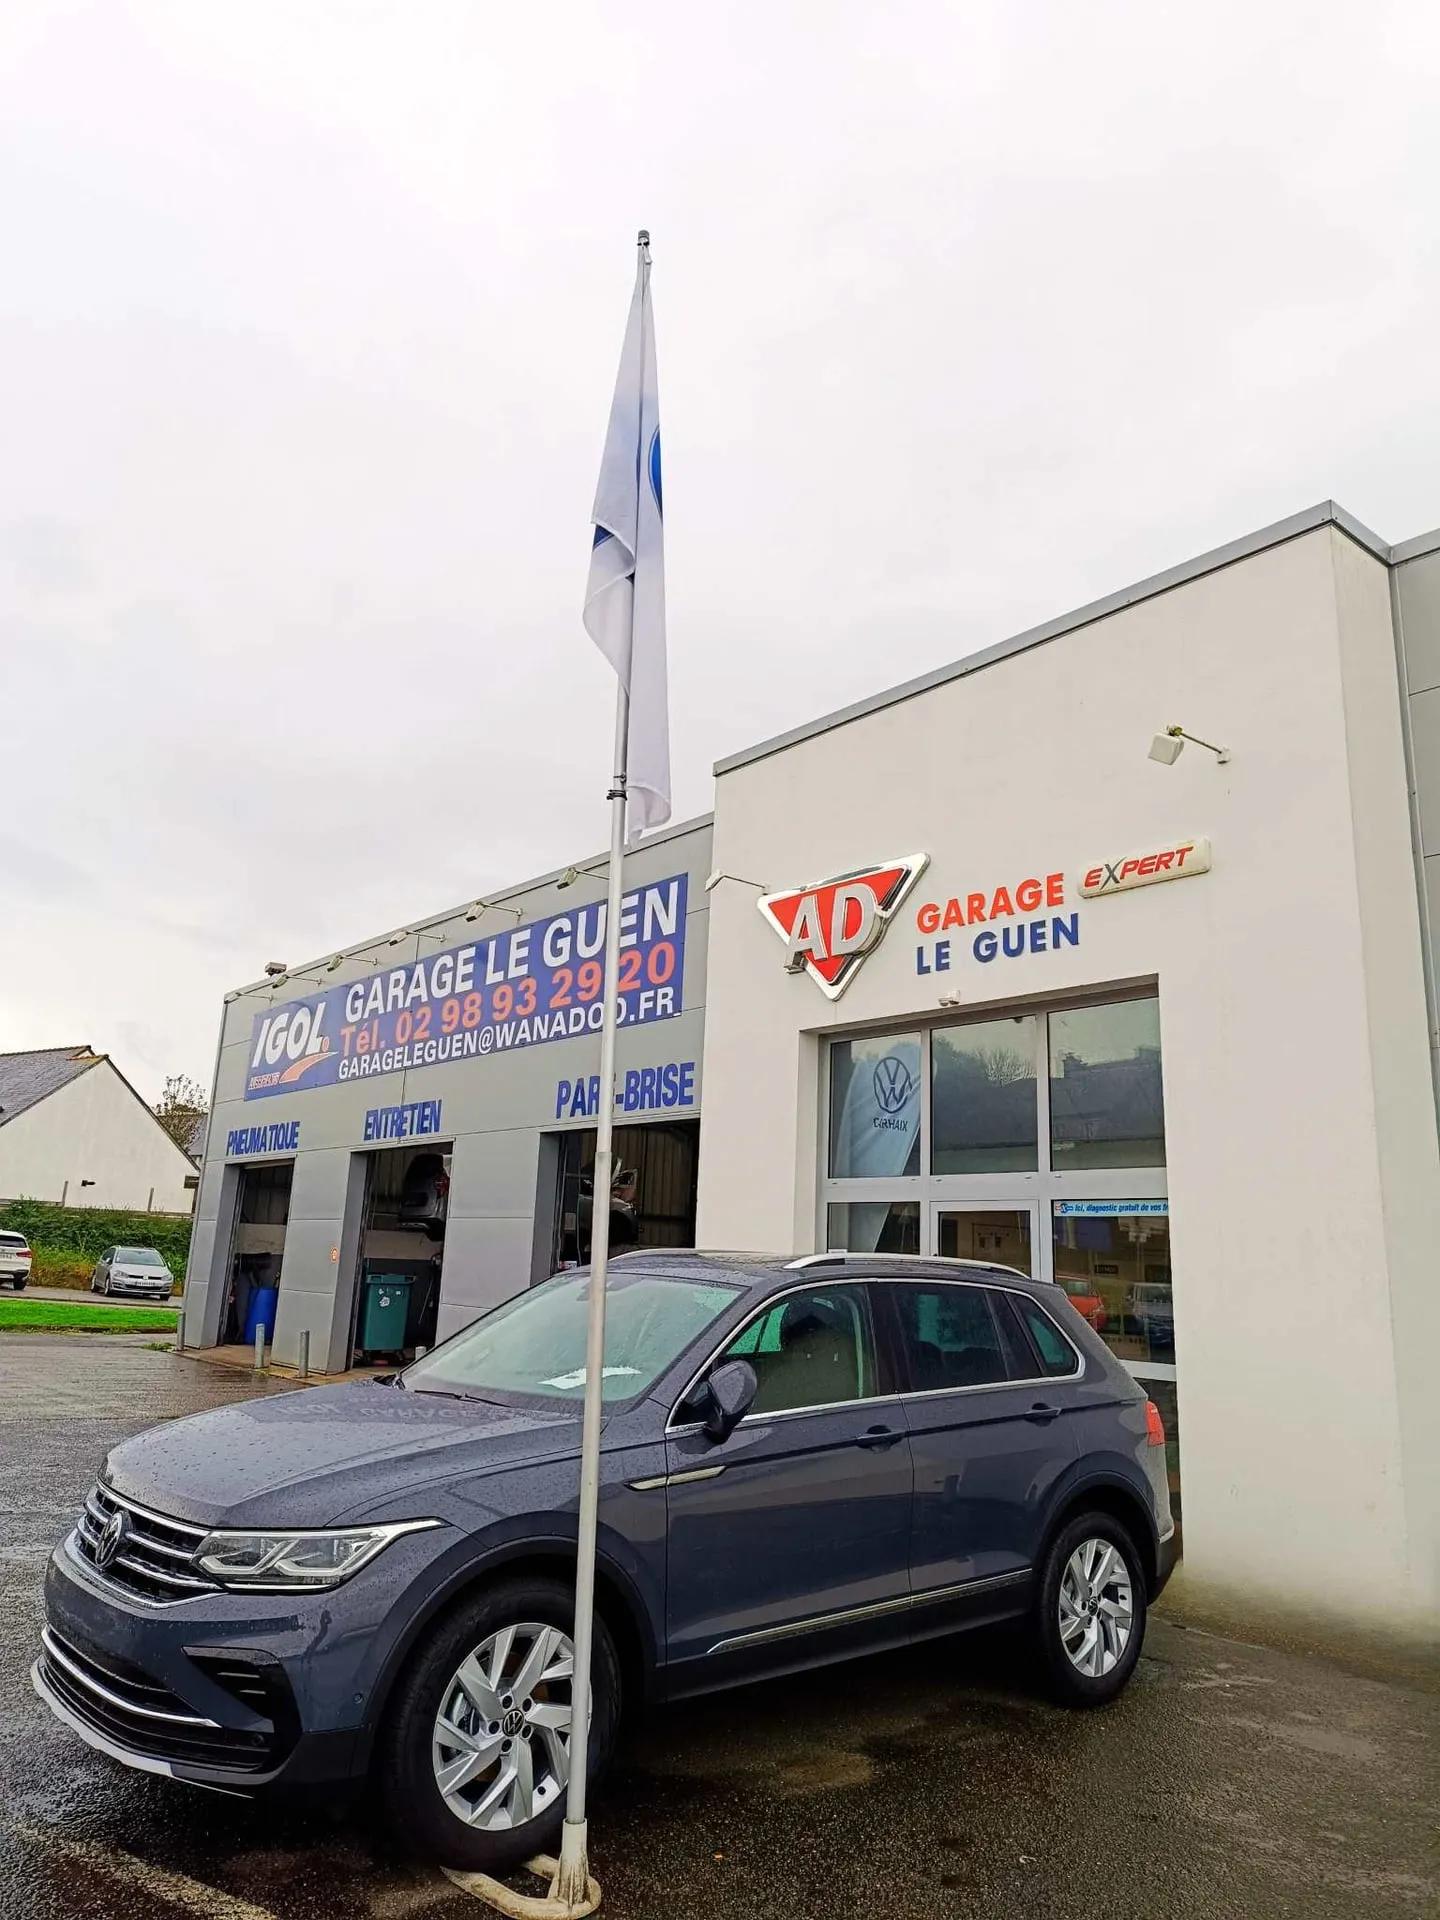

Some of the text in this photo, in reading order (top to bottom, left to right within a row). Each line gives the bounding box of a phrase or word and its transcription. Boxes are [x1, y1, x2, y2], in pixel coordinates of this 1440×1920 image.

[1084, 846, 1194, 890] EXPERT
[785, 882, 879, 961] AD
[917, 872, 1065, 935] GARAGE
[345, 880, 679, 1023] GARAGE LE GUEN
[916, 912, 1080, 976] LE GUEN
[340, 941, 676, 1058] Tél. 02 98 93 29 20
[251, 1002, 327, 1069] IGOL
[363, 1099, 443, 1141] ENTRETIEN
[556, 1061, 696, 1119] PAR-BRISE
[225, 1121, 301, 1156] PNEUMATIQUE
